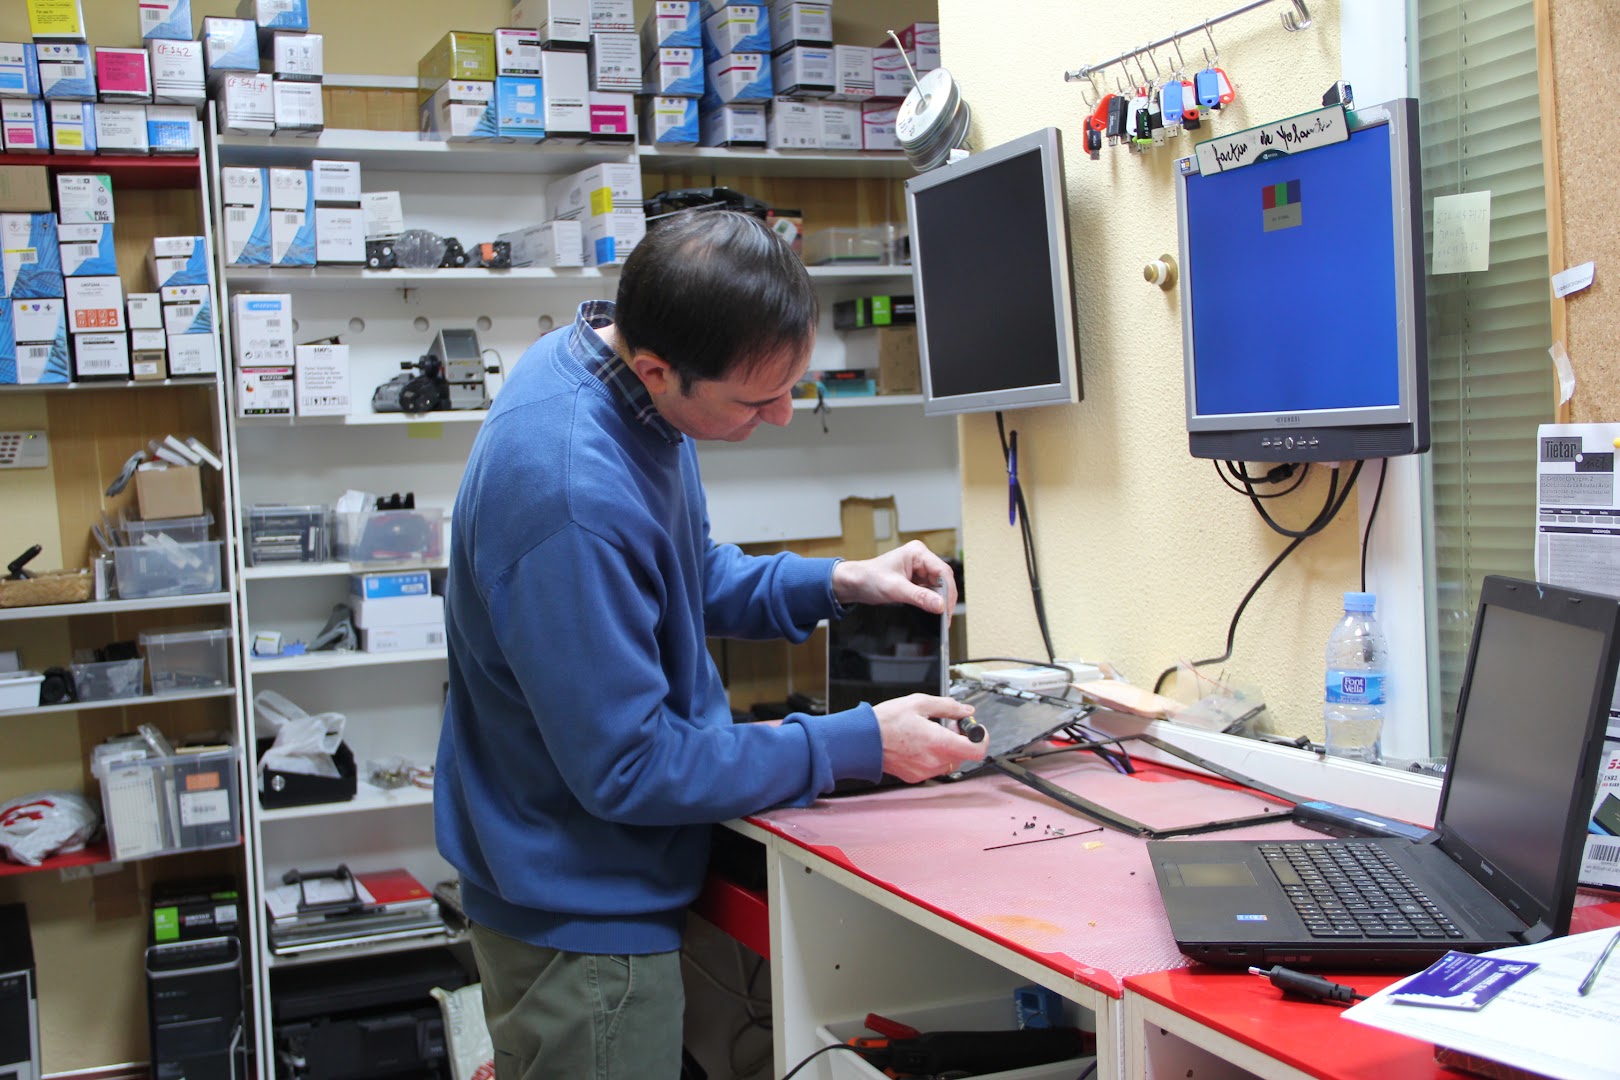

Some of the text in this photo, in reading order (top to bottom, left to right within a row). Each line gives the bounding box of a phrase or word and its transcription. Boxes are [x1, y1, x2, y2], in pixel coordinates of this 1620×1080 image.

[1545, 441, 1577, 458] Tietar
[1344, 678, 1364, 686] Font
[1344, 684, 1364, 693] Vella
